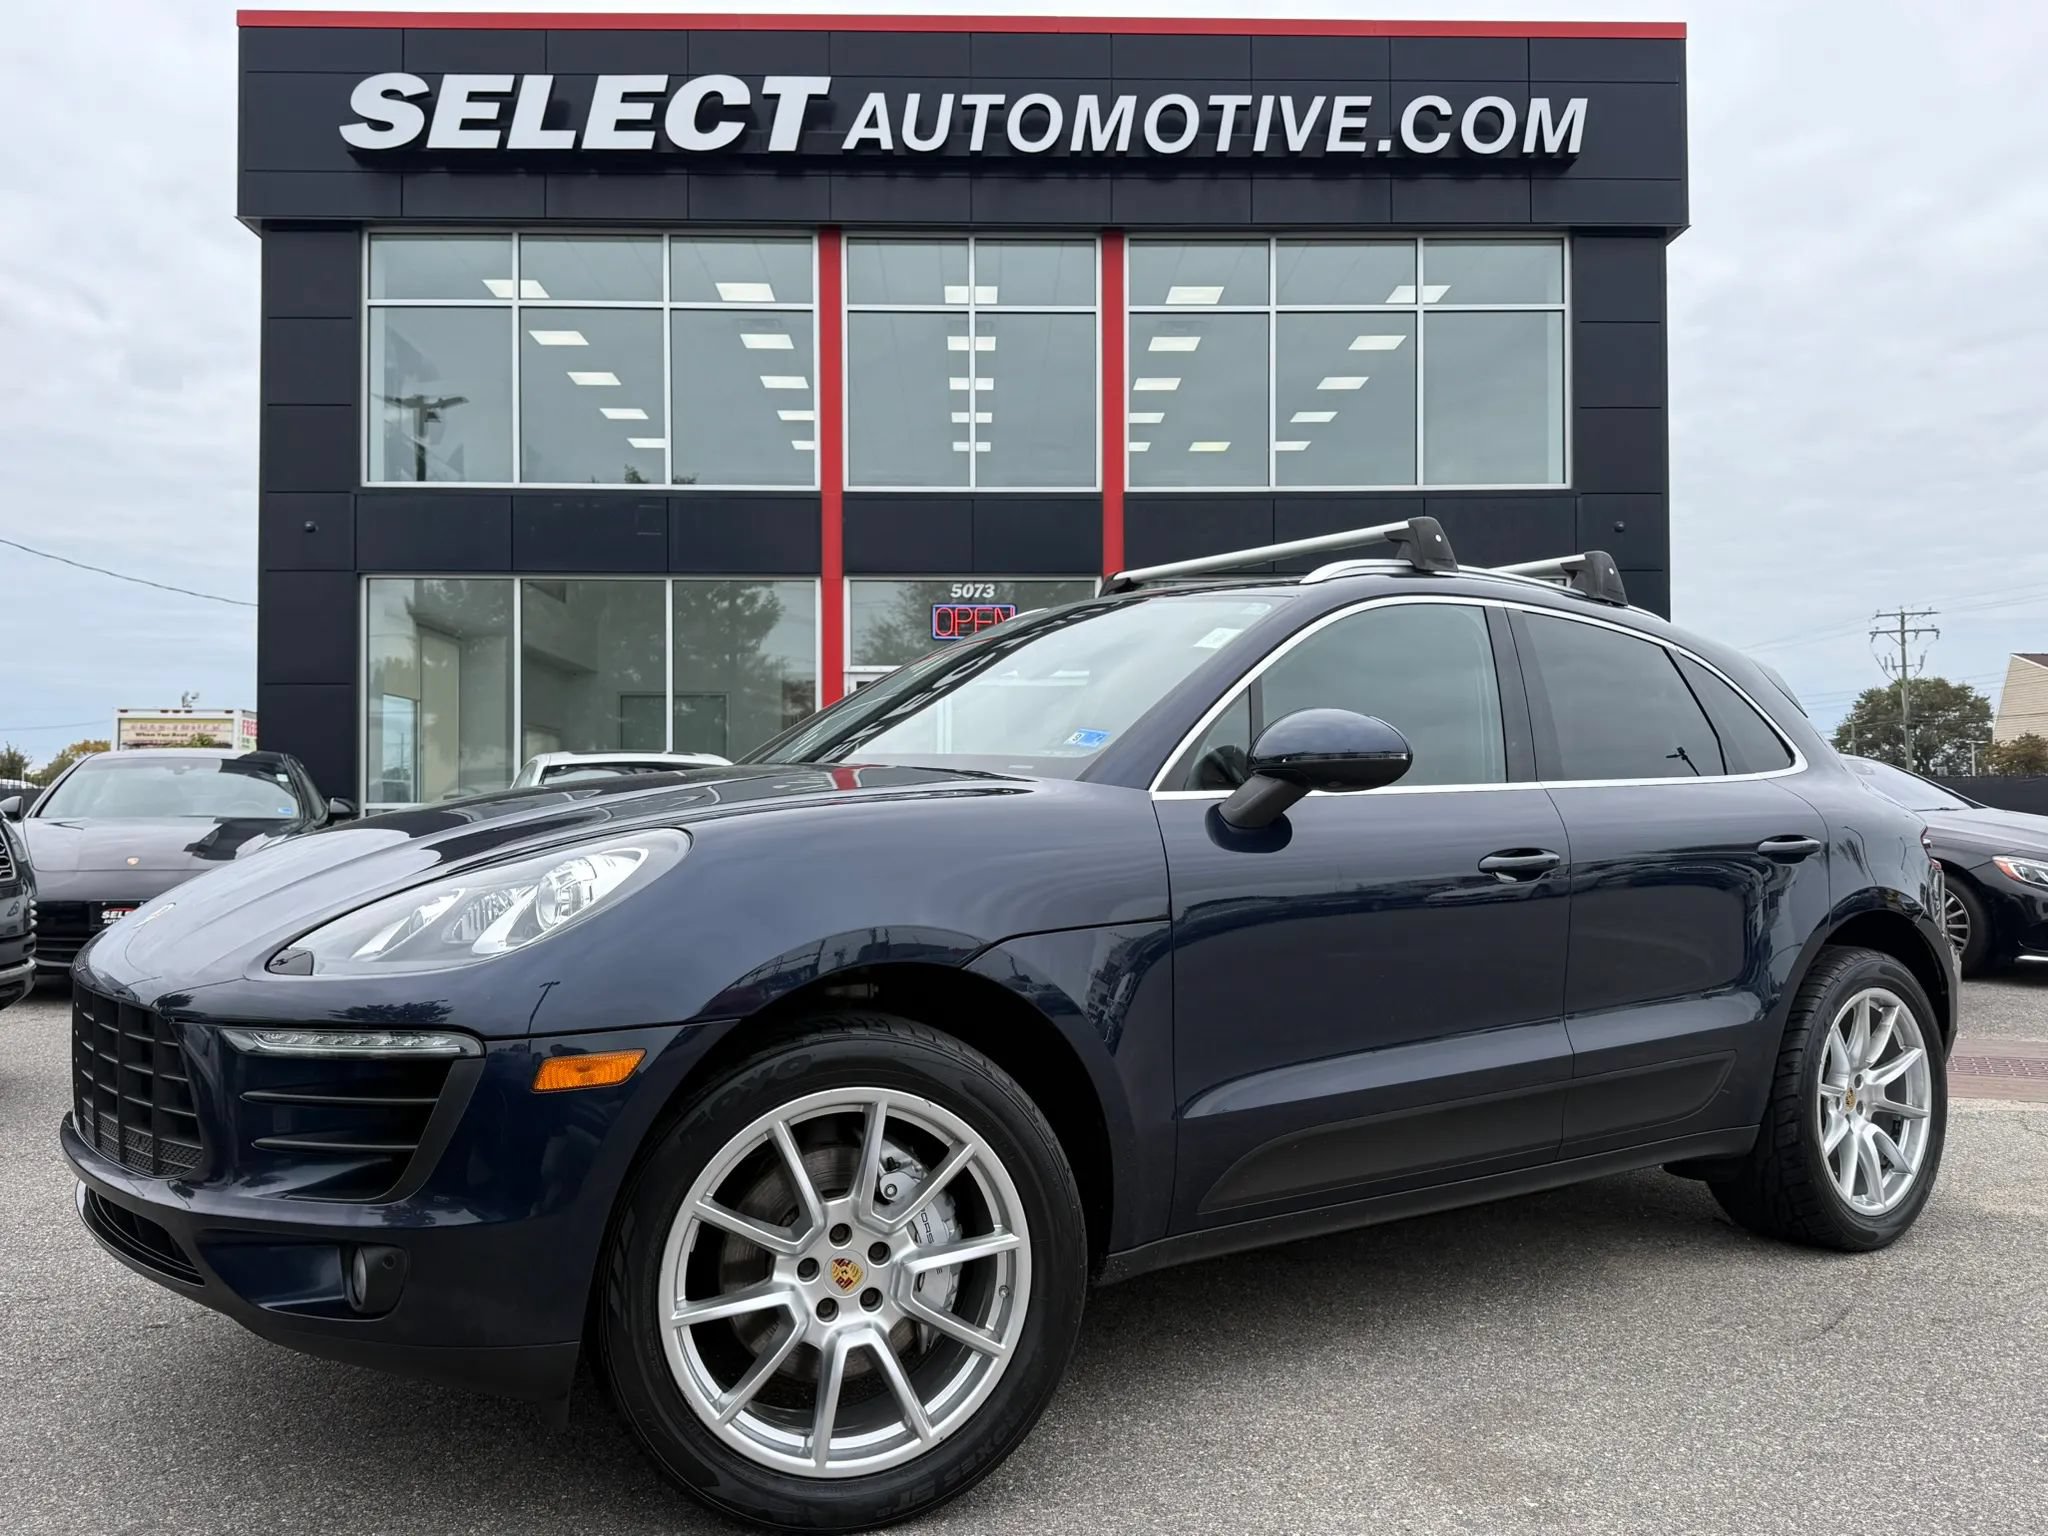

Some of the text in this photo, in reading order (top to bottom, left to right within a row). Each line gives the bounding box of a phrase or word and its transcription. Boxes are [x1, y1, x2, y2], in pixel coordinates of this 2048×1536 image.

[338, 72, 1588, 154] SELECT AUTOMOTIVE.COM
[951, 584, 996, 598] 5073
